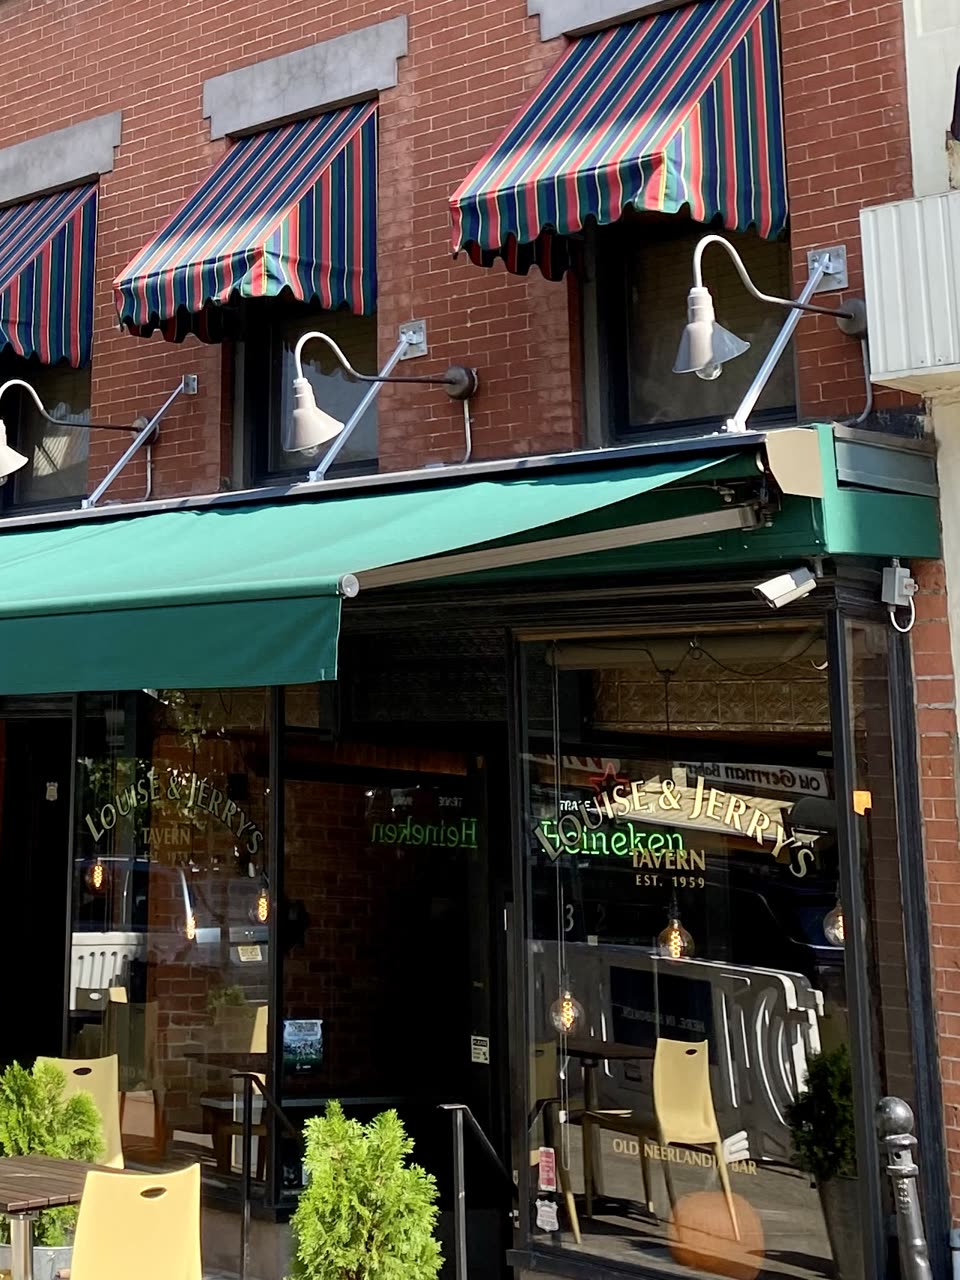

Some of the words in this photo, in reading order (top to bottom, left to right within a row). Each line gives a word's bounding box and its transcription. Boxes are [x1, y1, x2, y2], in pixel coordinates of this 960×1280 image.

[85, 773, 161, 843] LOUISE
[167, 775, 182, 801] &
[186, 772, 264, 855] JERRY'S
[533, 779, 648, 862] LOUISE
[658, 779, 682, 811] &
[688, 775, 816, 879] JERRY'S
[142, 827, 191, 845] TAVERN
[541, 820, 686, 856] Heineken
[632, 849, 706, 871] TAVERN
[635, 874, 663, 887] EST.
[671, 876, 705, 889] 1959
[613, 1138, 639, 1156] OLD
[644, 1143, 722, 1169] NEERLANDI
[731, 1160, 757, 1175] BAR
